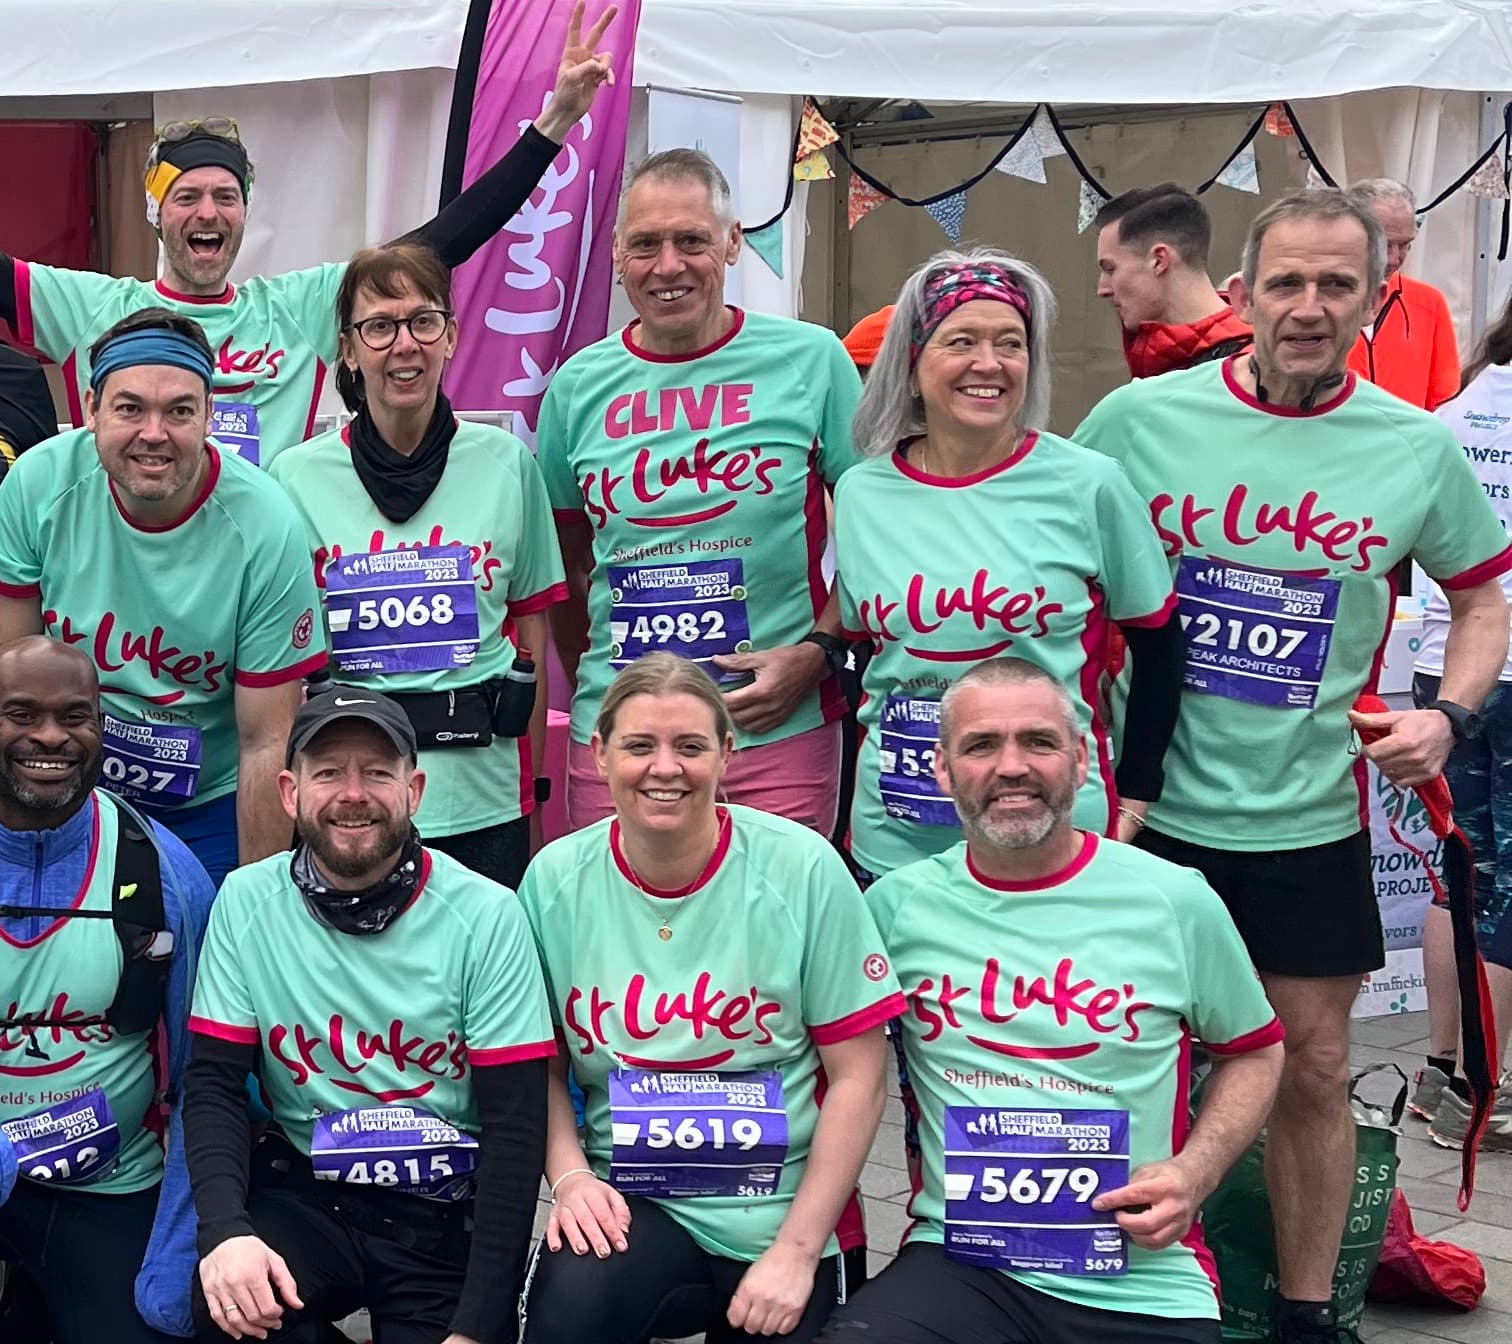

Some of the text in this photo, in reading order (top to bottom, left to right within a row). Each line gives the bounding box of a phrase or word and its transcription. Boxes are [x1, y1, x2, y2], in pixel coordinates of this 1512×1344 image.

[605, 383, 754, 439] CLIVE
[582, 438, 782, 529] St Luke's
[1149, 484, 1388, 571] St Luke's
[690, 535, 753, 553] Hospice
[370, 552, 417, 564] SHEFFIELD
[396, 557, 457, 571] MARATHON
[424, 568, 459, 581] 2023
[640, 567, 687, 579] SHEFFIELD
[667, 573, 728, 587] MARATHON
[1226, 570, 1282, 587] SHEFFIELD
[694, 584, 730, 598] 2023
[1224, 579, 1324, 604] HALF MARATHON
[358, 593, 455, 631] 5068
[906, 568, 1063, 639] Luke's
[1282, 601, 1322, 616] 2023
[631, 610, 727, 644] 4982
[1191, 613, 1308, 660] 2107
[93, 611, 228, 693] Luke's
[1220, 653, 1302, 678] ARCHITECTS
[106, 718, 152, 737] SHEFFIELD
[128, 732, 188, 750] MARATHON
[153, 747, 188, 762] 2023
[902, 749, 936, 777] 53
[909, 958, 1156, 1043] St Luke's
[565, 971, 781, 1055] St Luke's
[269, 1014, 468, 1086] St Luke's
[661, 1073, 718, 1084] SHEFFIELD
[944, 1068, 1115, 1096] Sheffield's Hospice
[694, 1083, 764, 1094] MARATHON
[726, 1093, 767, 1107] 2023
[33, 1110, 94, 1139] MARATHON
[360, 1110, 413, 1121] SHEFFIELD
[360, 1117, 453, 1131] HALF MARATH
[1001, 1114, 1060, 1125] SHEFFIELD
[64, 1120, 99, 1142] 2023
[420, 1128, 461, 1144] 2023
[647, 1119, 762, 1151] 5619
[1000, 1124, 1109, 1138] HALF MARATHON
[1067, 1138, 1110, 1152] 2023
[345, 1154, 455, 1187] 4815
[980, 1167, 1100, 1205] 5679
[1085, 1258, 1124, 1272] 5679
